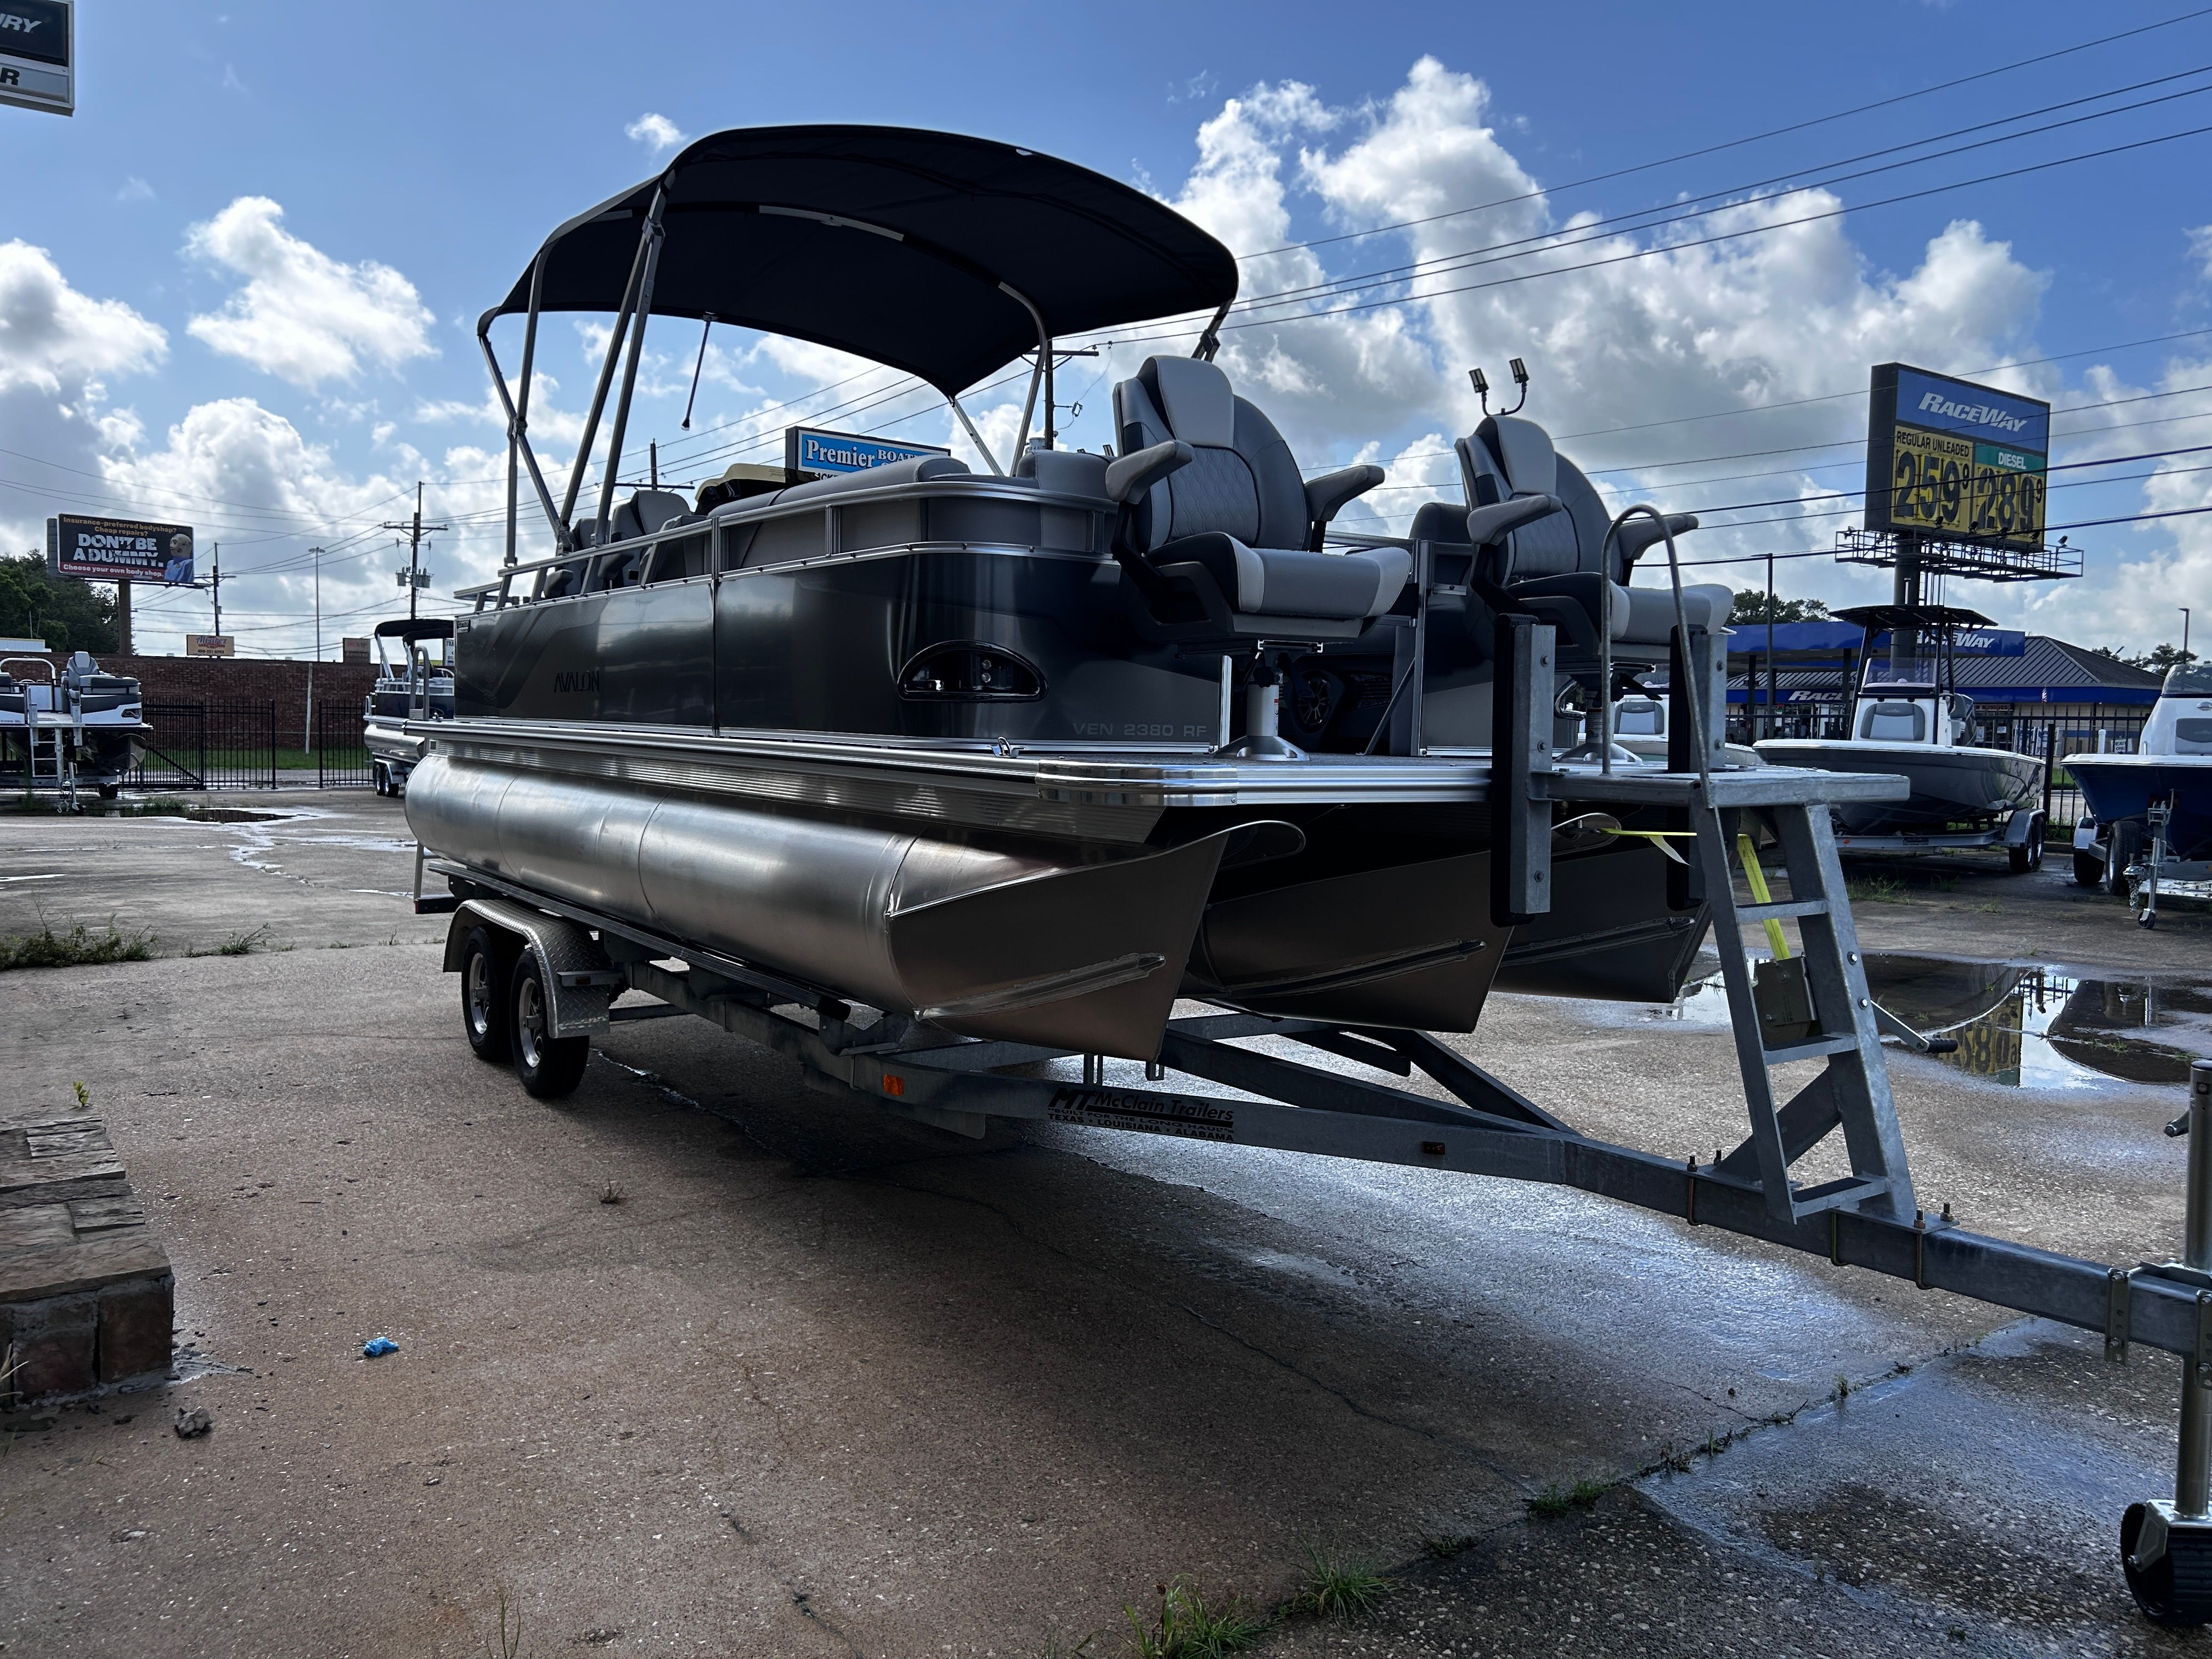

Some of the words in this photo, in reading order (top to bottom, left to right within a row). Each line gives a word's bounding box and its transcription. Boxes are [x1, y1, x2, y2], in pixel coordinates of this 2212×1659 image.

[806, 438, 875, 468] Premier
[1897, 431, 1931, 450] REGULAR
[1933, 438, 1970, 457] UNLEADED
[1998, 452, 2027, 470] DIESEL
[63, 516, 139, 530] Insurance-preferred
[139, 523, 177, 534] bodyshop?
[94, 526, 117, 534] Cheap
[78, 533, 135, 549] DON'T
[136, 537, 157, 551] BE
[73, 548, 87, 561] A
[88, 549, 164, 567] DUMMY.
[554, 670, 600, 693] AVALON
[1072, 723, 1114, 736] VEN
[1124, 724, 1175, 737] 2380
[1183, 725, 1207, 737] RF
[1094, 1091, 1164, 1113] McClain
[1170, 1099, 1234, 1120] Trailers
[1047, 1113, 1085, 1123] TEXAS
[1097, 1119, 1161, 1133] LOUISIANA
[1175, 1127, 1234, 1142] ALABAMA
[1140, 1118, 1184, 1127] LONG
